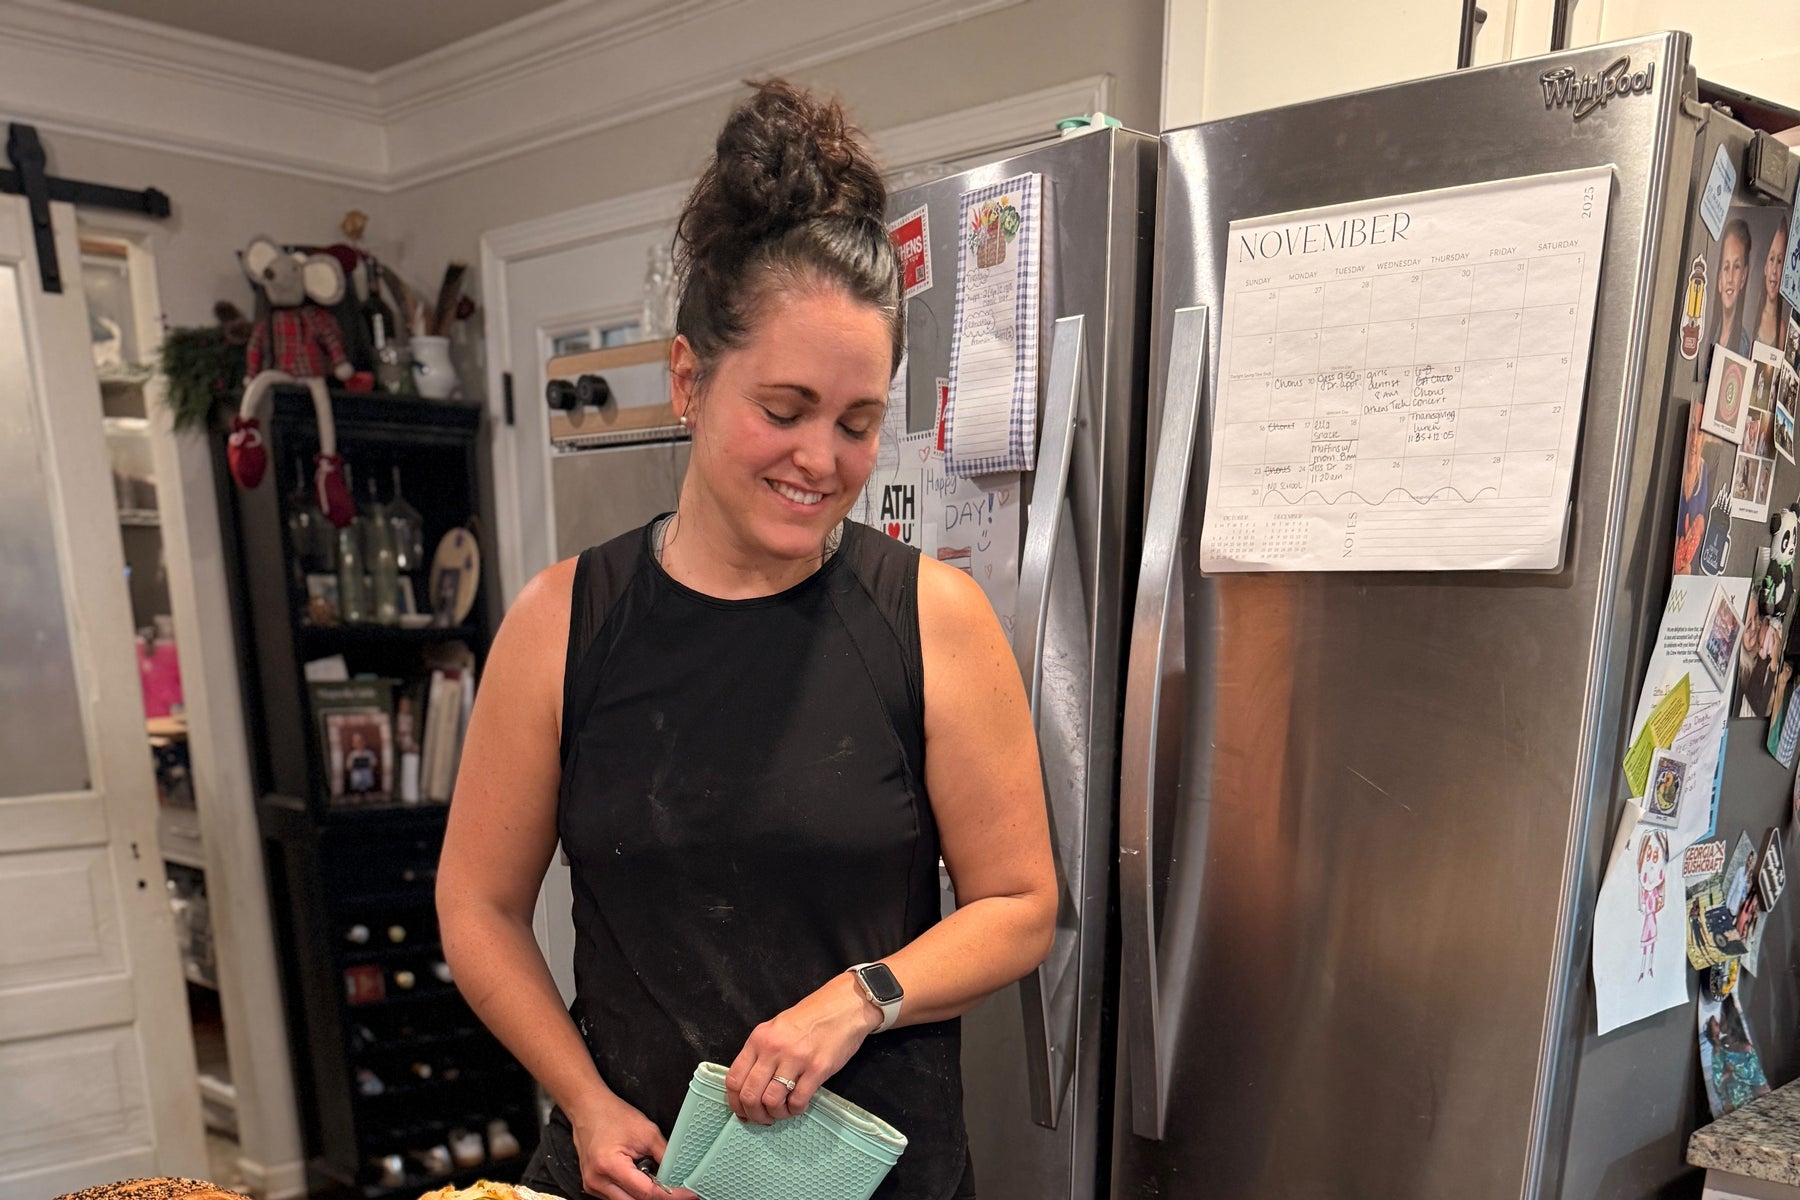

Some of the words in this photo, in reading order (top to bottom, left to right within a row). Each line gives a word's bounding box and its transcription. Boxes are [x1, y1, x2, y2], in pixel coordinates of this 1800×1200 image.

[1540, 55, 1656, 117] Whirlpool
[1581, 186, 1595, 219] 2025
[1239, 212, 1411, 263] NOVEMBER
[1245, 277, 1272, 287] SUNDAY
[1288, 271, 1318, 281] MONDAY
[1335, 265, 1366, 275] TUESDAY
[1377, 258, 1422, 270] WEDNESDAY
[1431, 252, 1470, 264] THURSDAY
[1489, 247, 1518, 257] FRIDAY
[1538, 239, 1579, 252] SATURDAY
[1268, 292, 1276, 300] 26
[1314, 286, 1322, 294] 27
[1361, 281, 1370, 289] 28
[1411, 275, 1419, 283] 29
[1462, 269, 1471, 277] 30
[1517, 263, 1525, 271] 31
[1506, 361, 1513, 369] 14
[1560, 357, 1568, 365] 15
[1367, 379, 1400, 391] dentist
[1413, 386, 1445, 397] Chorus
[1412, 397, 1447, 407] concert
[1500, 409, 1507, 417] 21
[1552, 405, 1561, 414] 22
[1441, 458, 1450, 466] 27
[1492, 456, 1501, 464] 28
[1545, 454, 1554, 462] 29
[926, 468, 957, 498] Happy
[880, 485, 915, 520] ATH
[945, 493, 995, 532] DAY!
[1342, 511, 1358, 558] NOTES
[1683, 857, 1723, 875] BUSHCRAFT
[1685, 845, 1714, 860] GEORGIA
